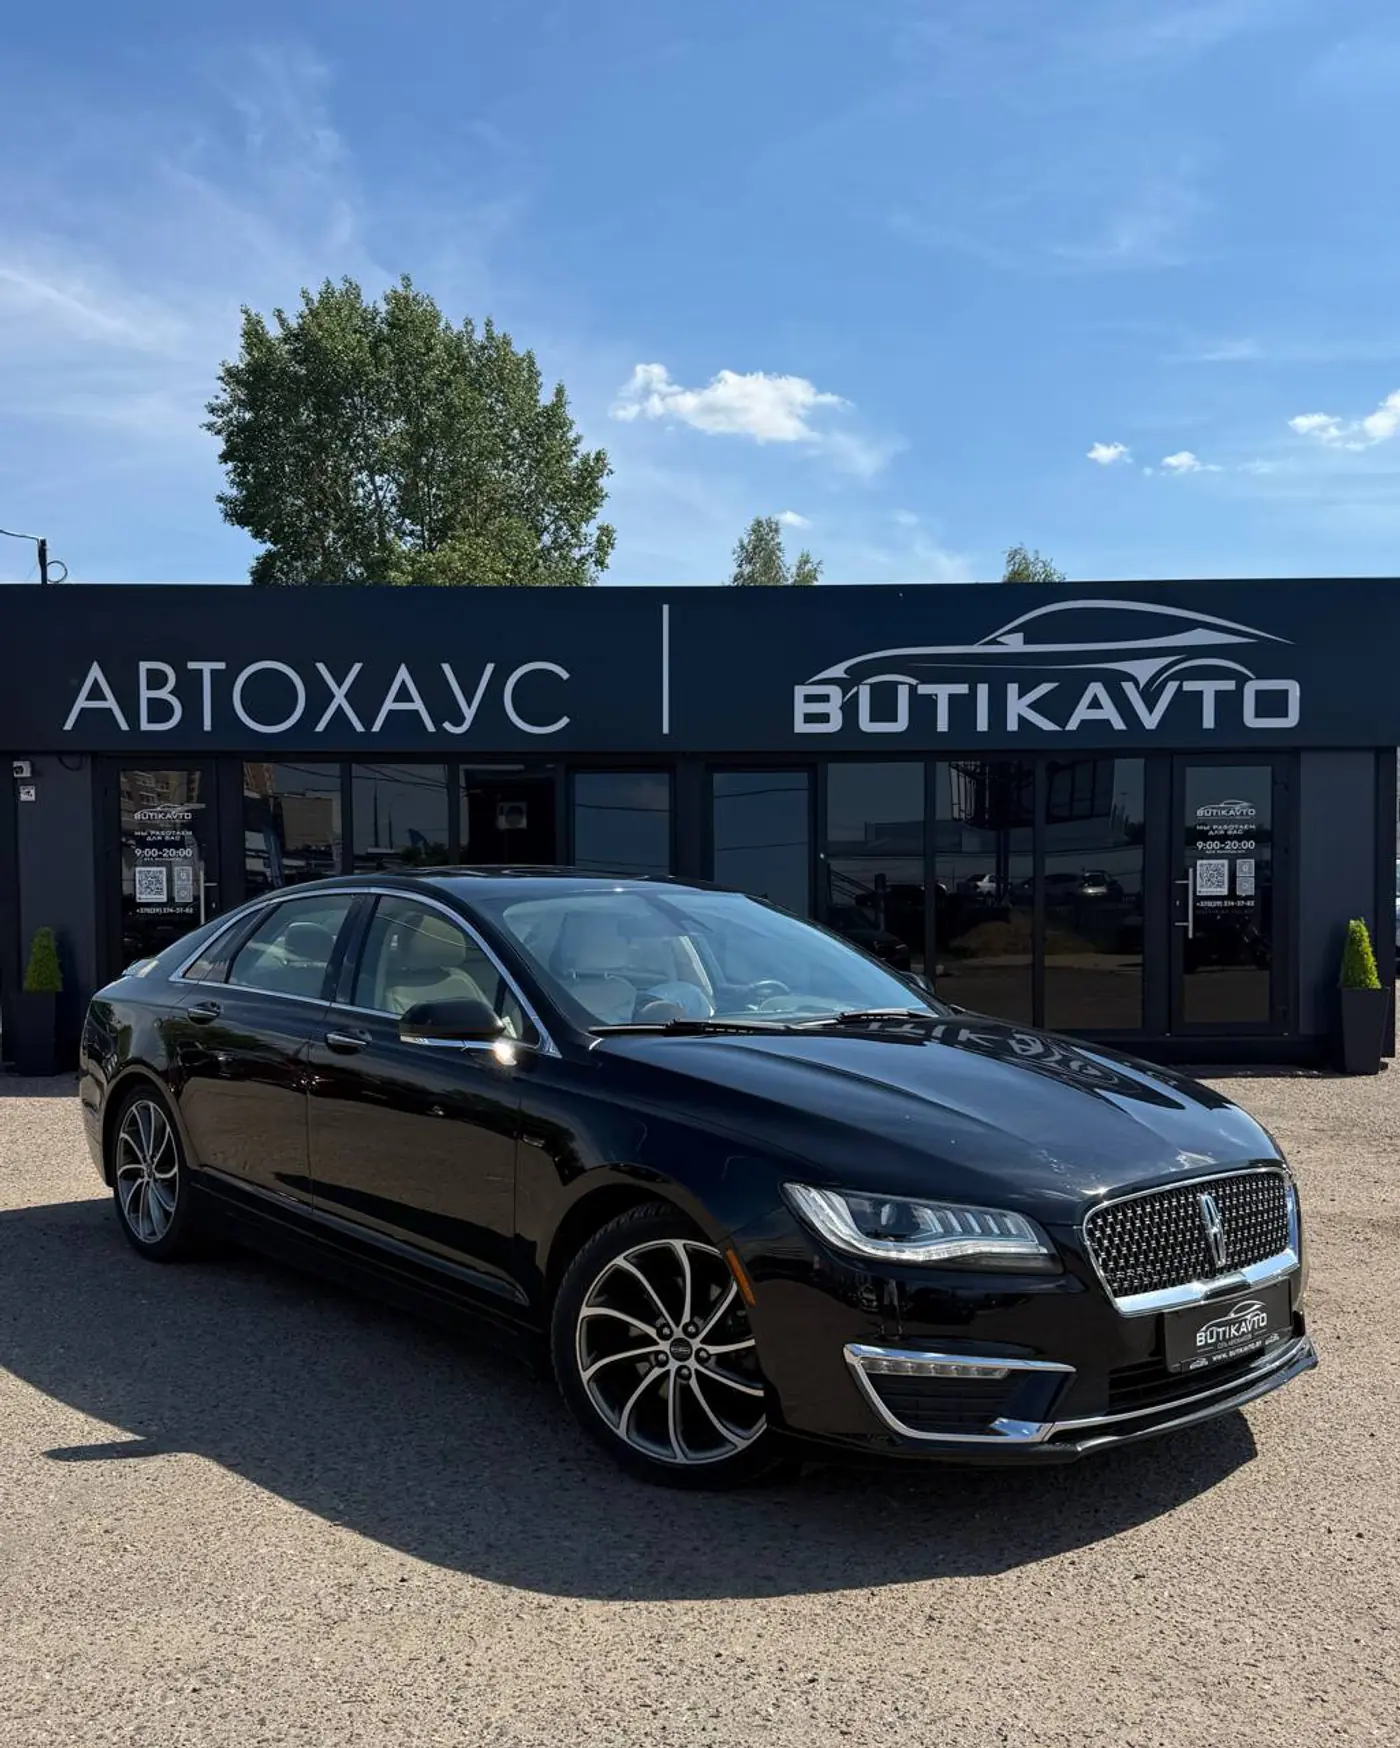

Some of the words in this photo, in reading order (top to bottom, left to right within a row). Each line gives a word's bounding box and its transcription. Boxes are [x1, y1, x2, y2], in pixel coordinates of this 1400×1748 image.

[62, 659, 571, 734] АВТОХАУС
[794, 678, 1301, 734] BUTIKAVTO
[134, 812, 193, 820] BUTIKAVTO
[1196, 808, 1256, 817] BUTIKAVTO
[1196, 840, 1256, 850] 9:00-20:00
[134, 848, 193, 857] 9:00-20:00
[1196, 1311, 1267, 1346] BUTIKAVTO
